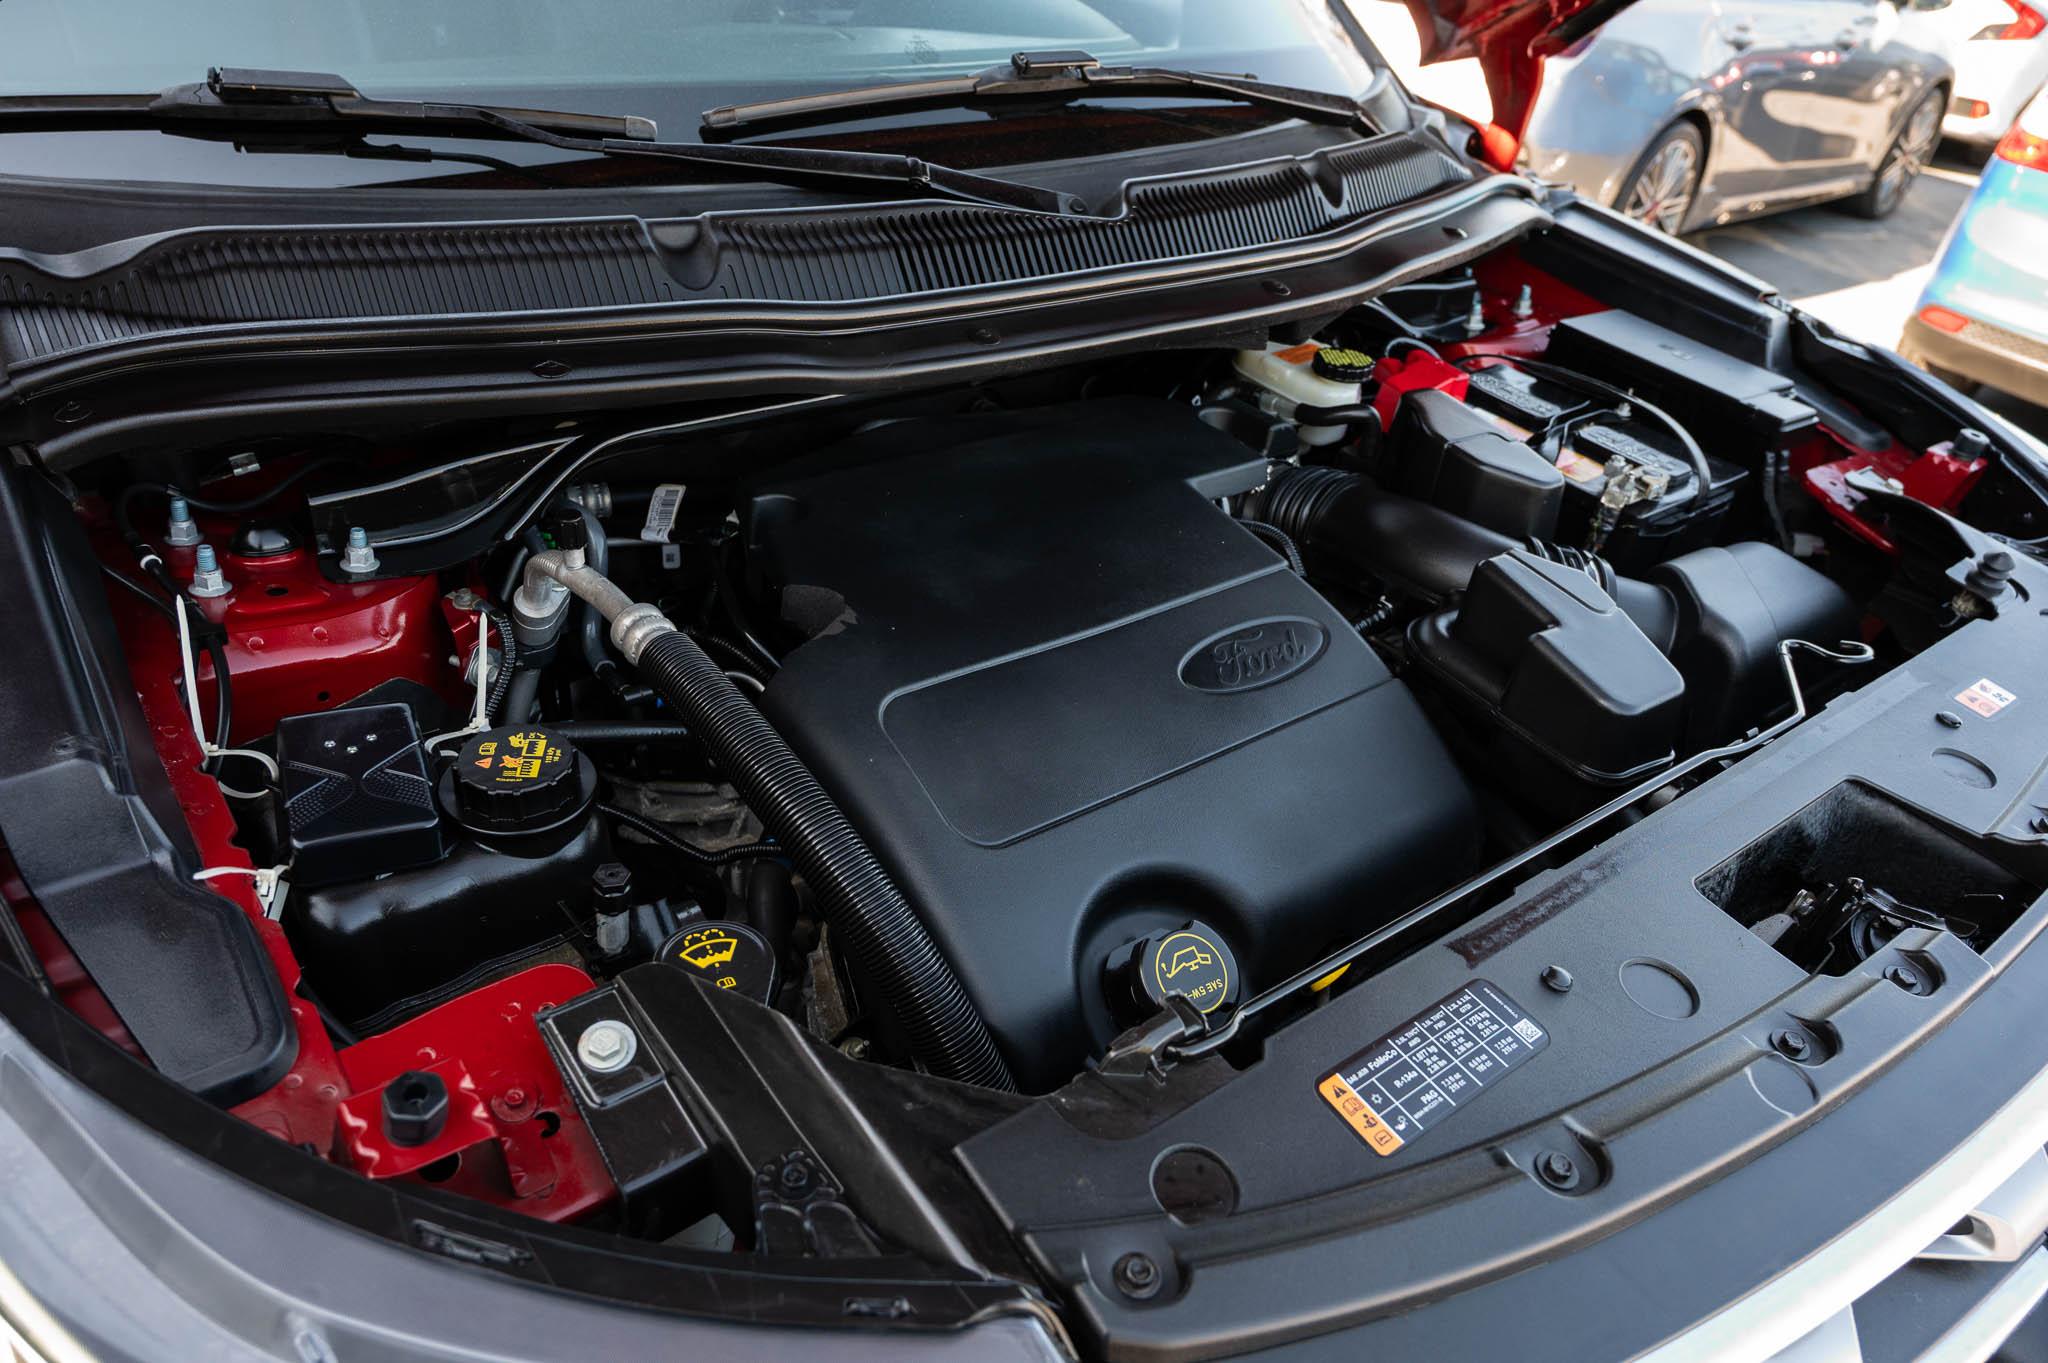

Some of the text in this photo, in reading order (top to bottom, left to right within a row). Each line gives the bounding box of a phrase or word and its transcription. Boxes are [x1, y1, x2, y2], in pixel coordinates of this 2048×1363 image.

[1214, 627, 1306, 686] Ford
[1184, 978, 1223, 1000] SAE 5W-
[1477, 1010, 1490, 1018] kg
[1452, 1027, 1464, 1035] kg
[1367, 1049, 1398, 1070] FoMoCo
[1412, 1045, 1438, 1063] 1.077 kg
[1393, 1070, 1418, 1088] R-134a
[1420, 1089, 1438, 1104] PAG
